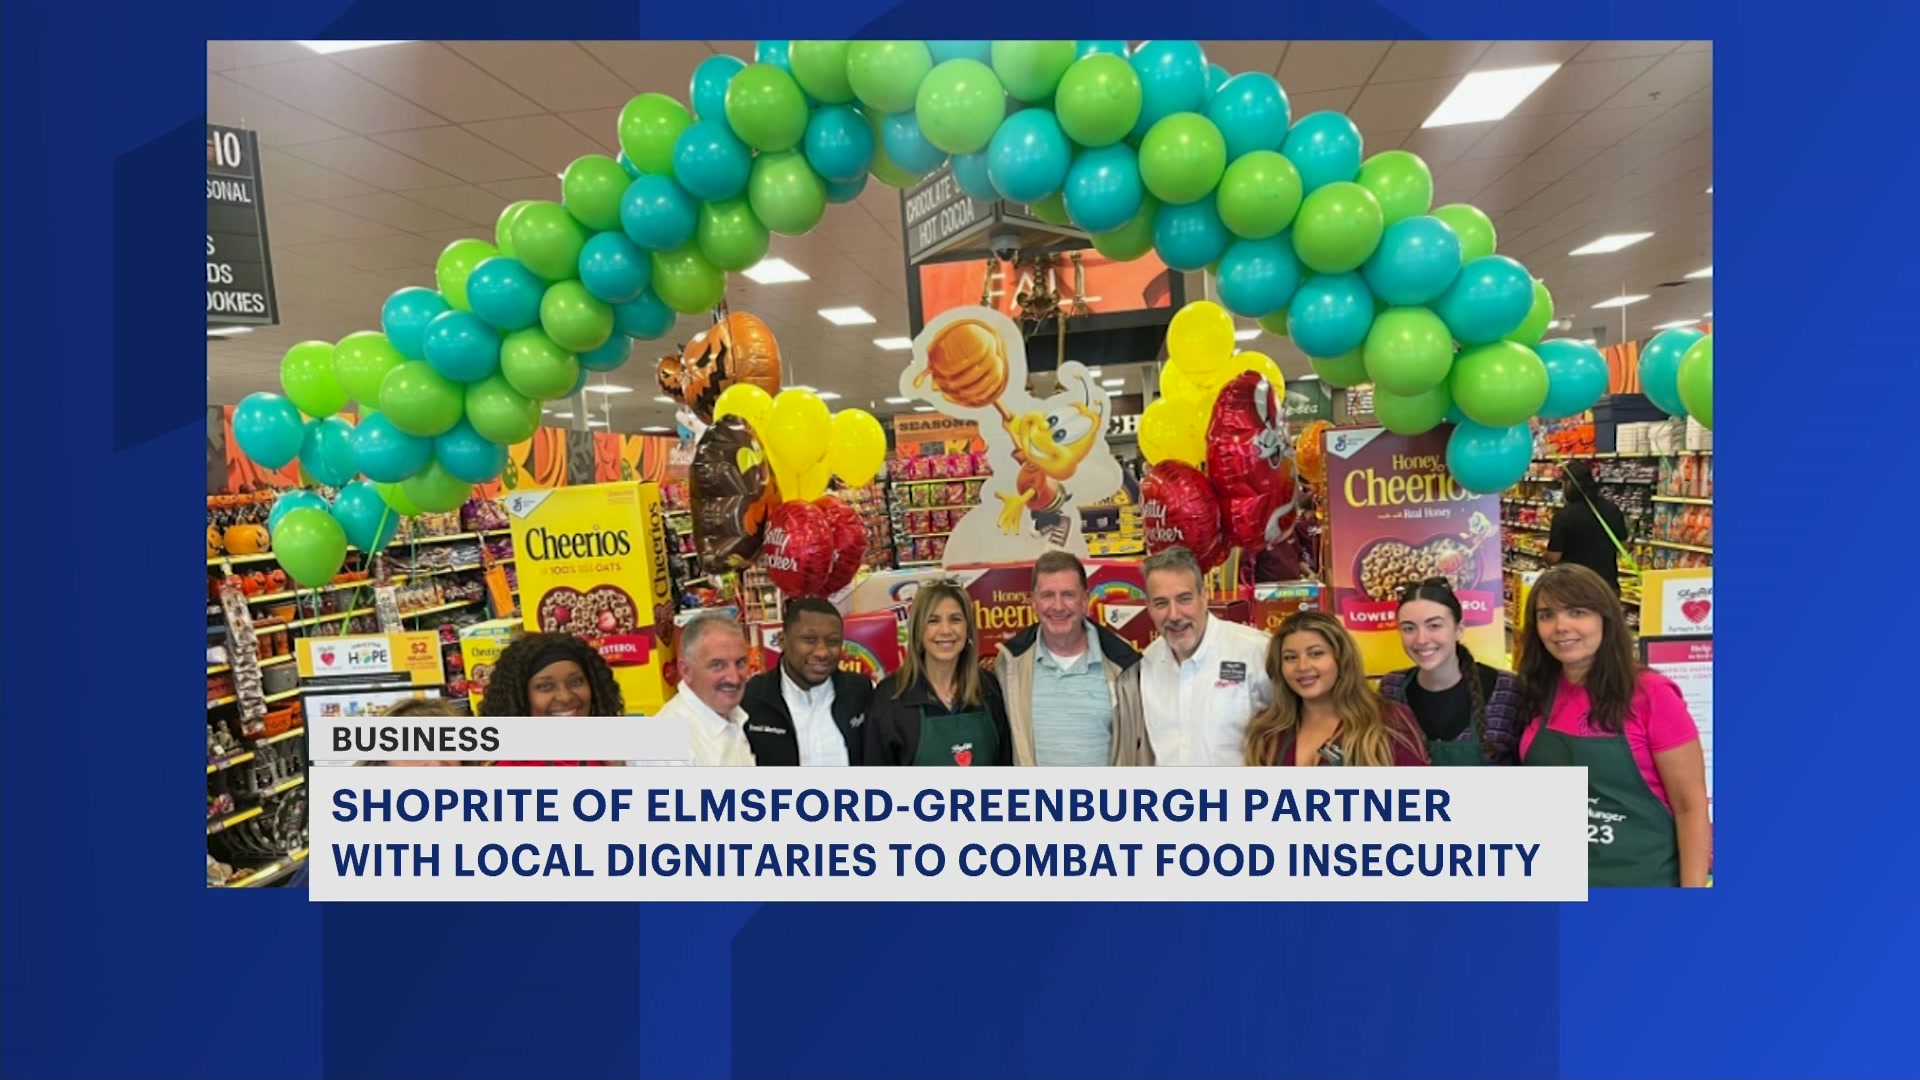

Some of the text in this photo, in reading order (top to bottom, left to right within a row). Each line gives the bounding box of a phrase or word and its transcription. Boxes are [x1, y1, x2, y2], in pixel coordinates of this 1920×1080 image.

[905, 174, 952, 224] CHOCOLATE
[917, 197, 976, 250] HOT COCOA
[1392, 454, 1441, 473] Honey
[1343, 467, 1483, 508] Cheerio
[1424, 506, 1451, 519] Honey
[525, 525, 631, 562] Cheerios
[648, 501, 669, 598] Cheerios
[993, 590, 1029, 605] Honey
[1350, 611, 1396, 623] LOWER
